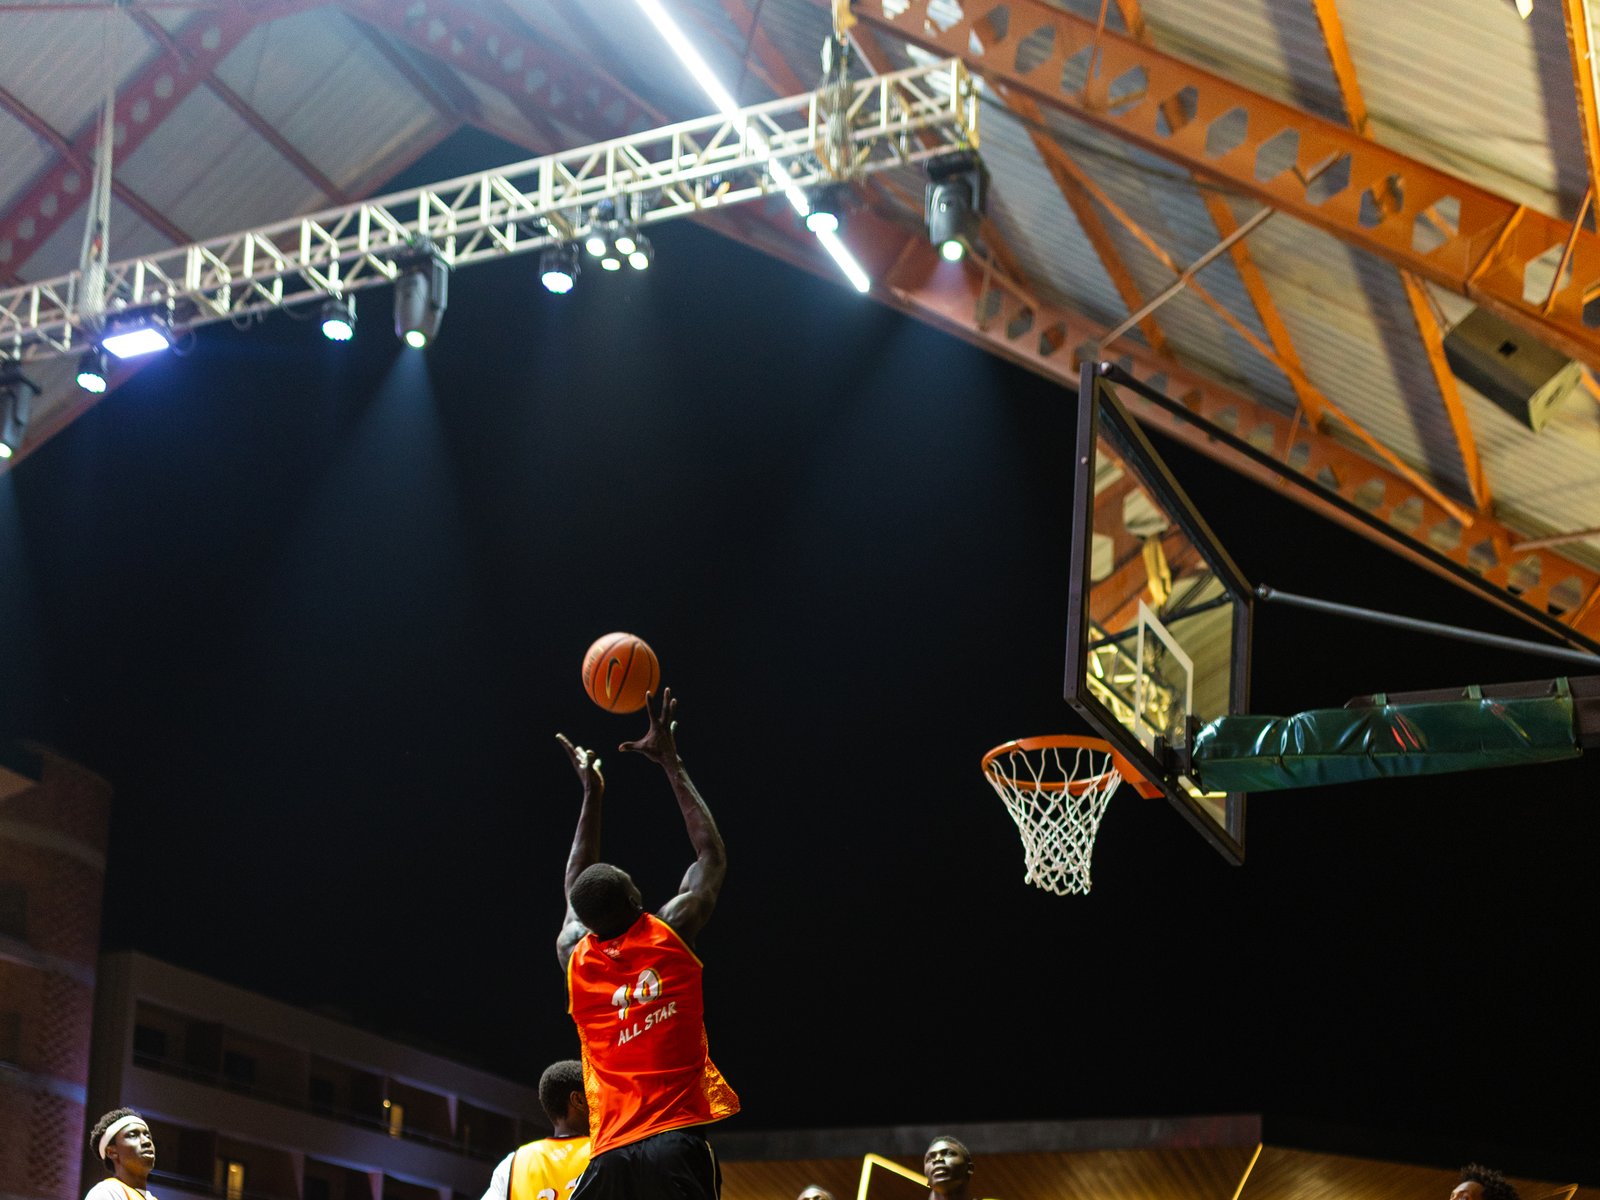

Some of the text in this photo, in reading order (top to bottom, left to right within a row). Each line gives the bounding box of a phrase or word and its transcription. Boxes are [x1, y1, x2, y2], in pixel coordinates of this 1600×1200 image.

[612, 967, 662, 1020] 10
[618, 1001, 677, 1046] ALL STAR
